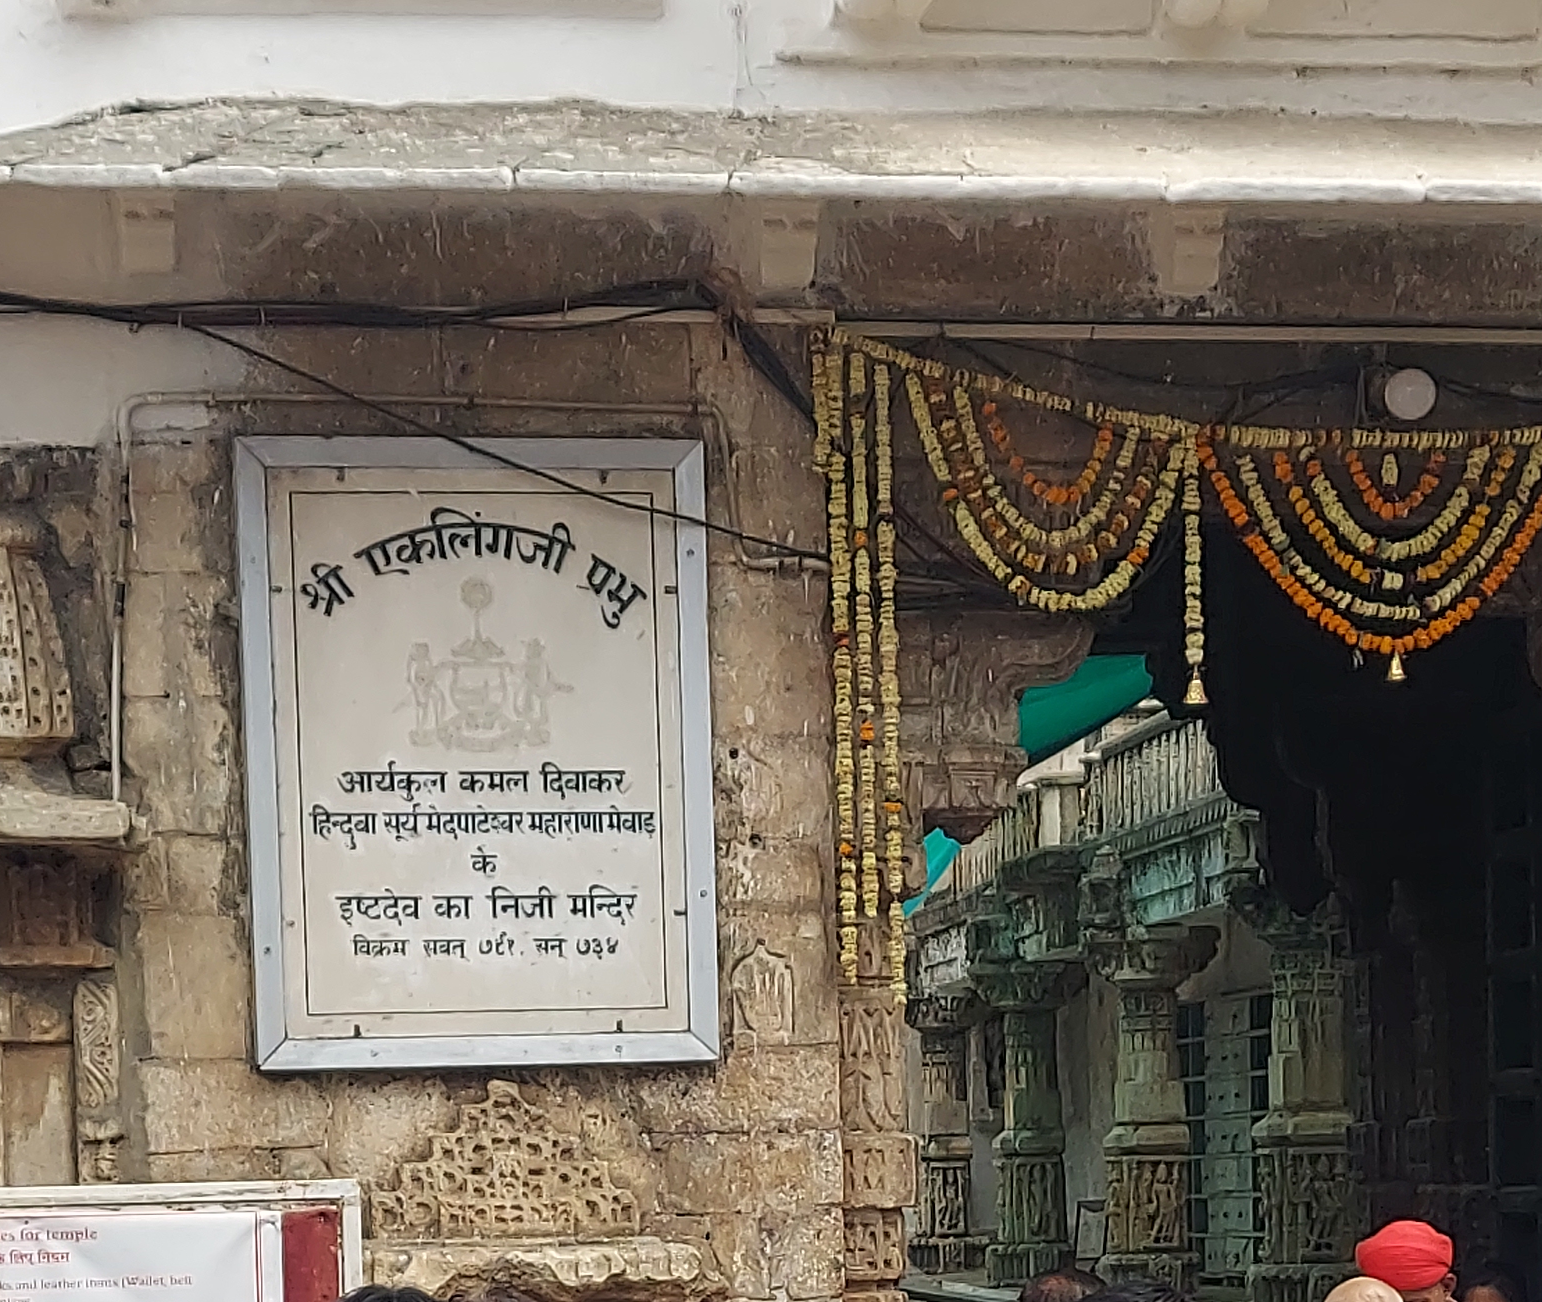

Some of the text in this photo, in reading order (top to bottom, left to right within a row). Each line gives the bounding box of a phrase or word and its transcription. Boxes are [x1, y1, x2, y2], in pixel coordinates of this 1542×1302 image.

[300, 507, 647, 628] श्री एकलिंगजी प्रभु
[338, 761, 630, 801] आर्यकुल कमल दिवाकर
[383, 803, 419, 842] सूर्य
[527, 812, 603, 841] महाराणा
[470, 846, 498, 875] के
[335, 884, 637, 926] इष्टदेव का निजी मन्दिर
[353, 935, 409, 957] विक्रम
[46, 1227, 97, 1242] temple
